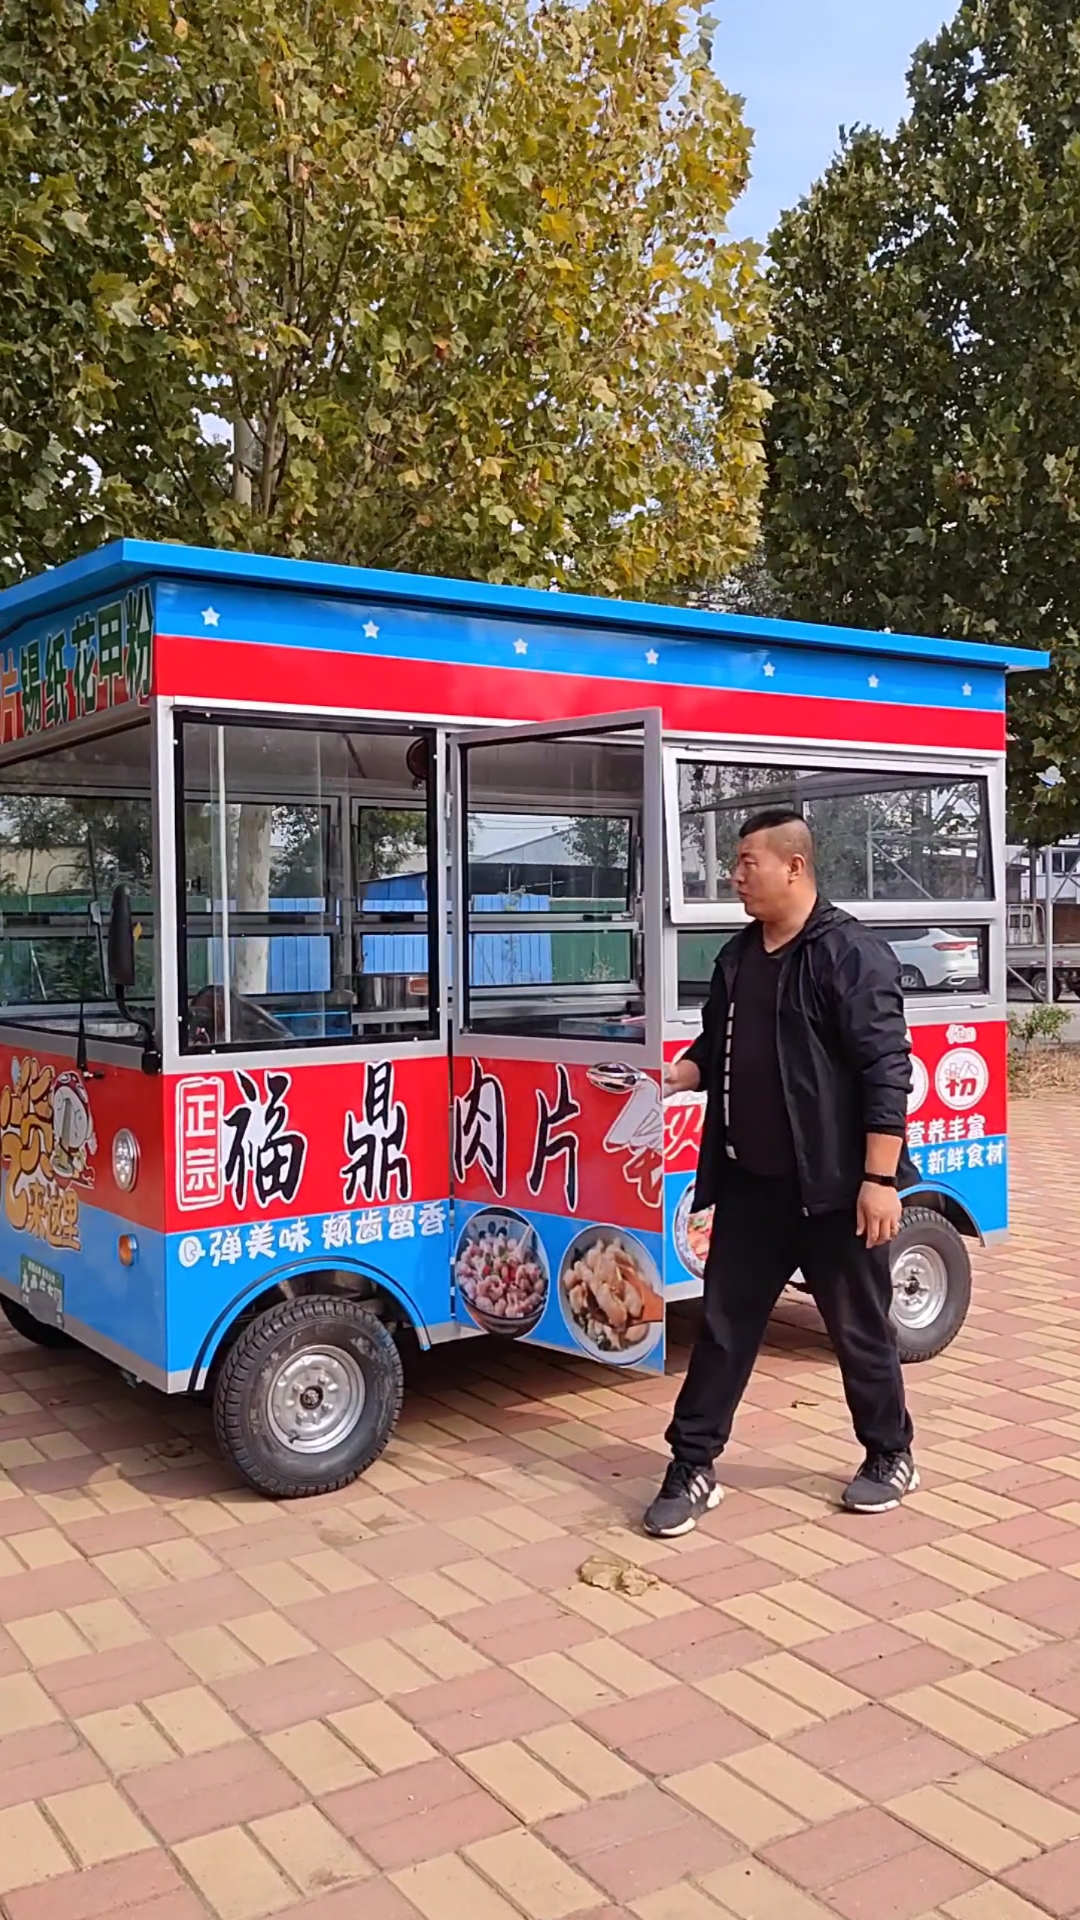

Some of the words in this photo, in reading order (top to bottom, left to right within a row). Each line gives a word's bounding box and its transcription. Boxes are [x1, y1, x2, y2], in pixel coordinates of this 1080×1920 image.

[945, 1060, 979, 1097] 粉
[186, 1095, 216, 1191] 正宗
[222, 1060, 412, 1211] 福鼎
[453, 1057, 581, 1213] 肉片
[907, 1113, 986, 1147] 营养丰富
[927, 1140, 1004, 1174] 新鲜食材
[179, 1217, 312, 1268] Q弹美味
[321, 1200, 448, 1249] 颊齿留香
